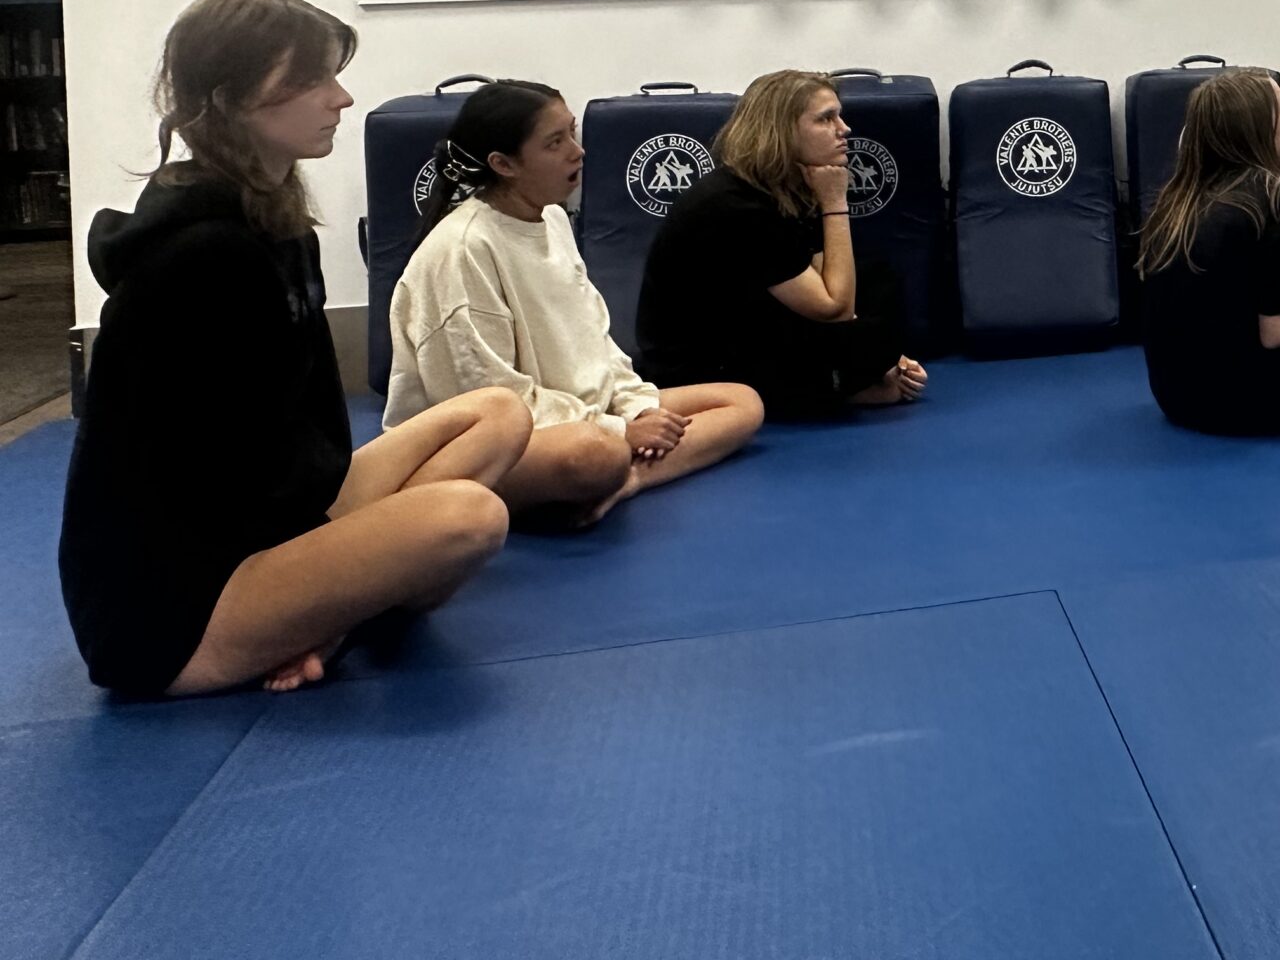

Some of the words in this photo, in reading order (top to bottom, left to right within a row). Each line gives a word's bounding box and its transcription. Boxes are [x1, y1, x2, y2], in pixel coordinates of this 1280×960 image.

[629, 138, 666, 183] VALENTE
[669, 136, 713, 175] BROTHER
[853, 140, 896, 183] BROTHERS
[999, 121, 1031, 166] VALENTE
[1033, 120, 1074, 163] BROTHERS
[850, 196, 883, 215] UTSU
[1010, 176, 1063, 194] JUJUTSU
